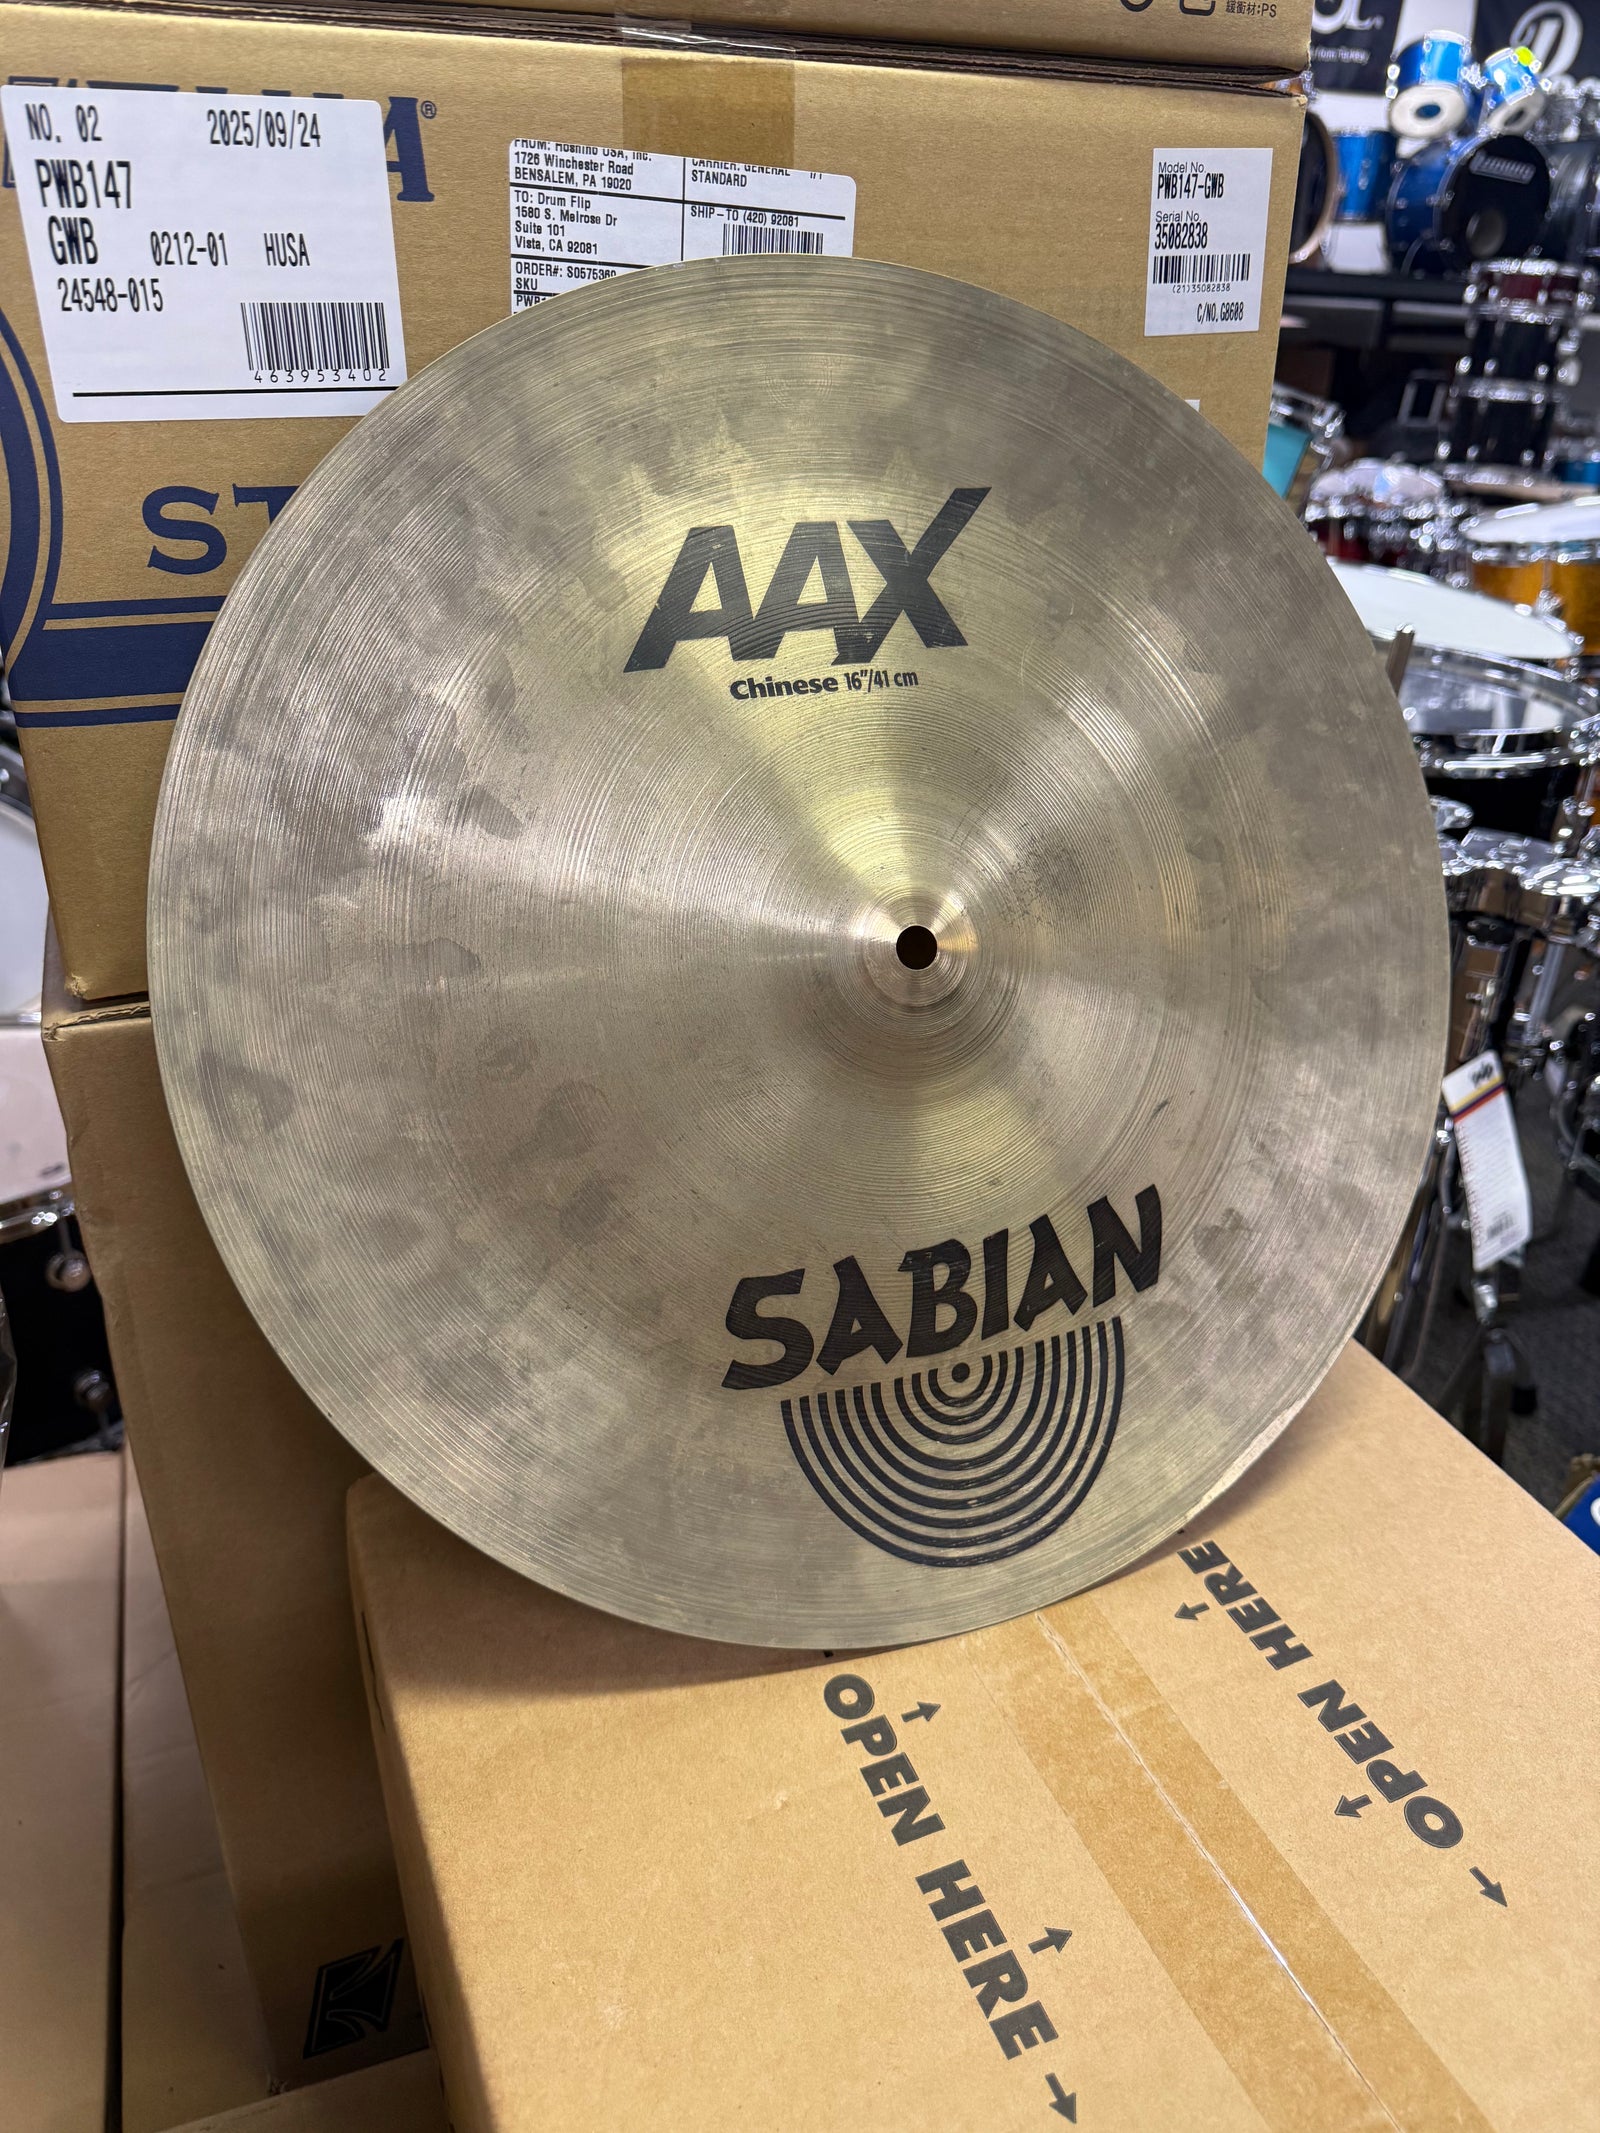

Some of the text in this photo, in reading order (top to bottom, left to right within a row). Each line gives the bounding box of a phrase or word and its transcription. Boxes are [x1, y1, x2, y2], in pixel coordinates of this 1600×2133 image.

[25, 103, 102, 143] NO. 02
[206, 109, 321, 149] 2025/09/24
[515, 152, 634, 176] 1726 Winchester Road
[1158, 162, 1206, 173] Model No.
[35, 159, 132, 209] PWB147
[515, 167, 632, 191] BENSALEM, PA 19020
[691, 169, 747, 188] STANDARD
[1157, 173, 1225, 199] PWB147-GWB
[514, 190, 591, 211] TO: Drum Flip
[515, 206, 618, 226] 1580 S. Melrose Dr
[515, 220, 565, 237] Suite 101
[743, 210, 767, 226] (420)
[771, 214, 799, 227] 92081
[1155, 211, 1201, 222] Serial No.
[48, 216, 98, 265] GWB
[150, 231, 229, 266] 0212-01
[515, 235, 598, 255] Vista, CA 92081
[1155, 222, 1208, 250] 35082838
[263, 233, 311, 267] HUSA
[515, 262, 563, 277] ORDER#:
[57, 278, 164, 312] 24548-015
[516, 277, 538, 290] SKU
[1172, 283, 1231, 293] (21)35082838
[623, 486, 992, 673] AAX
[730, 676, 839, 701] Chinese
[893, 670, 919, 688] cm
[721, 1184, 1163, 1390] SABIAN
[1177, 1540, 1464, 1849] OPEN HERE
[823, 1673, 1059, 2060] OPEN HERE
